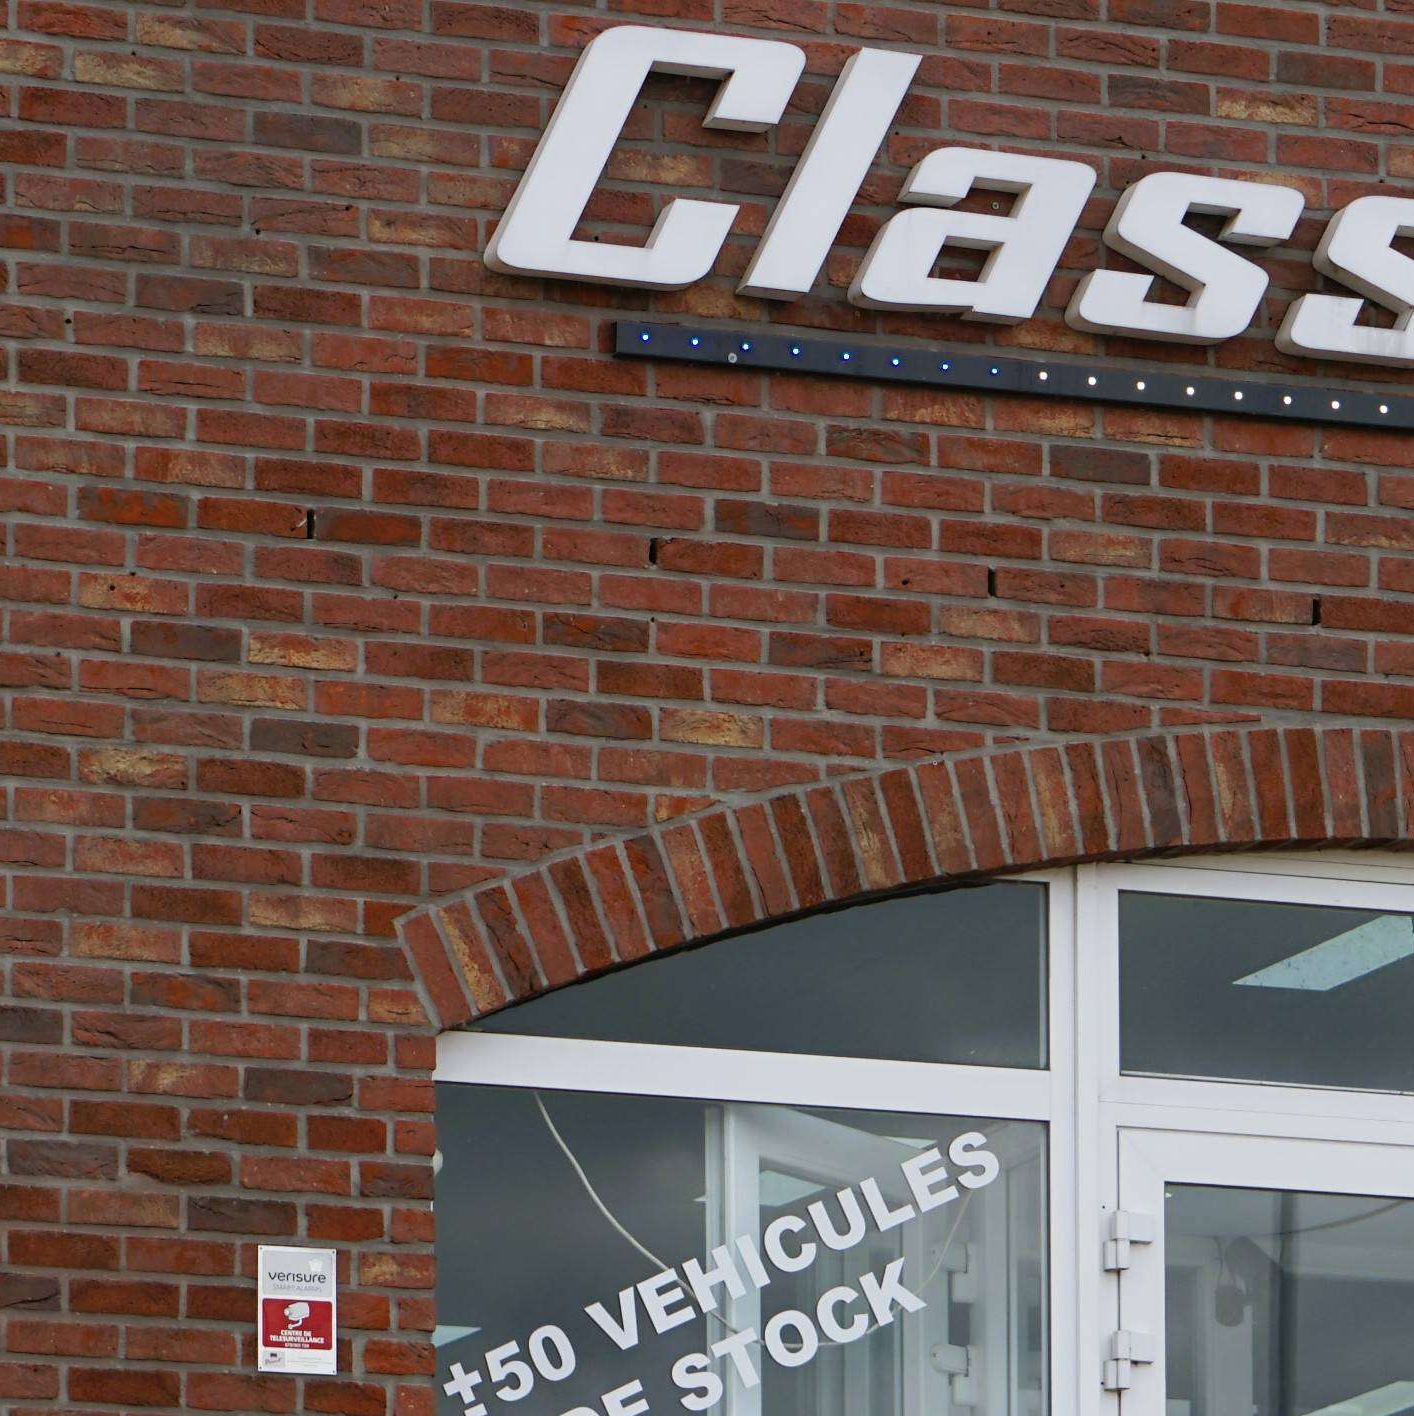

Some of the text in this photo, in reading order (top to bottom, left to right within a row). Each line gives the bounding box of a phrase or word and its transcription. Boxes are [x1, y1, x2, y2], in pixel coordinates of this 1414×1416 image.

[268, 1271, 327, 1284] verisure
[584, 1131, 1000, 1351] VEHICULES
[671, 1256, 927, 1412] STOCK
